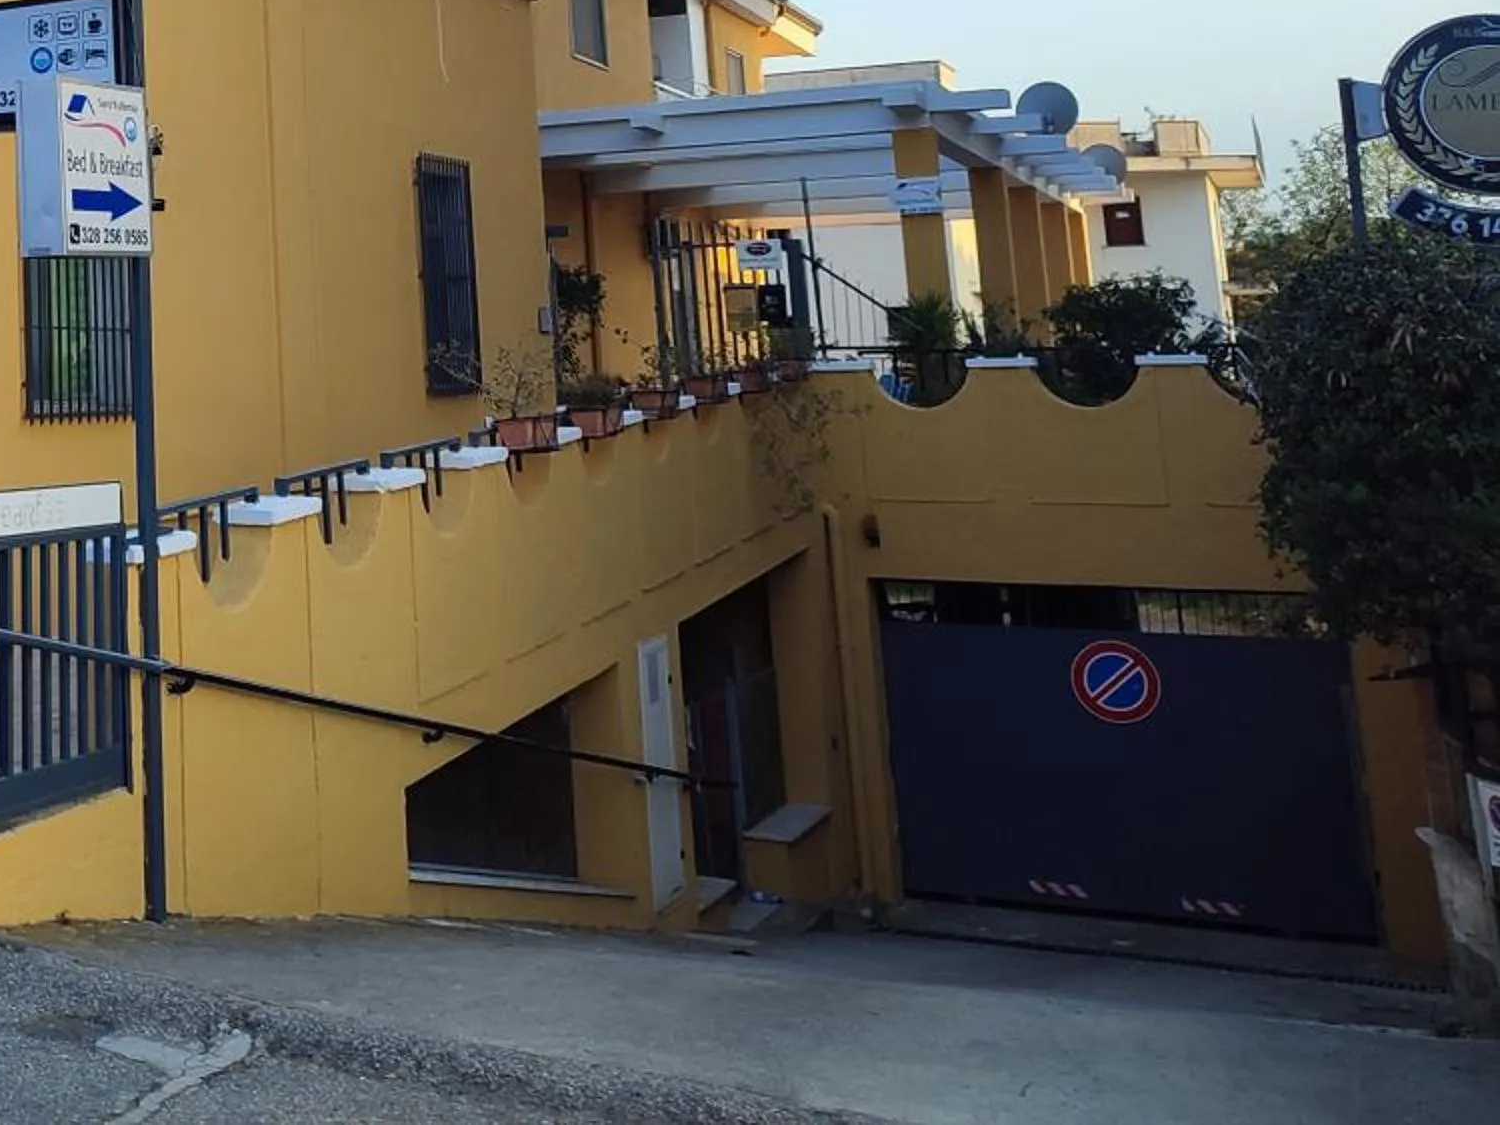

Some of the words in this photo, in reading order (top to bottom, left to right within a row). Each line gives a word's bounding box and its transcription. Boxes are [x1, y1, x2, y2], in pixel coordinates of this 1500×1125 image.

[67, 148, 87, 173] Bed
[90, 153, 98, 174] &
[100, 152, 144, 178] Breakfast
[81, 226, 101, 244] 328
[103, 227, 123, 245] 256
[125, 229, 149, 246] 0585
